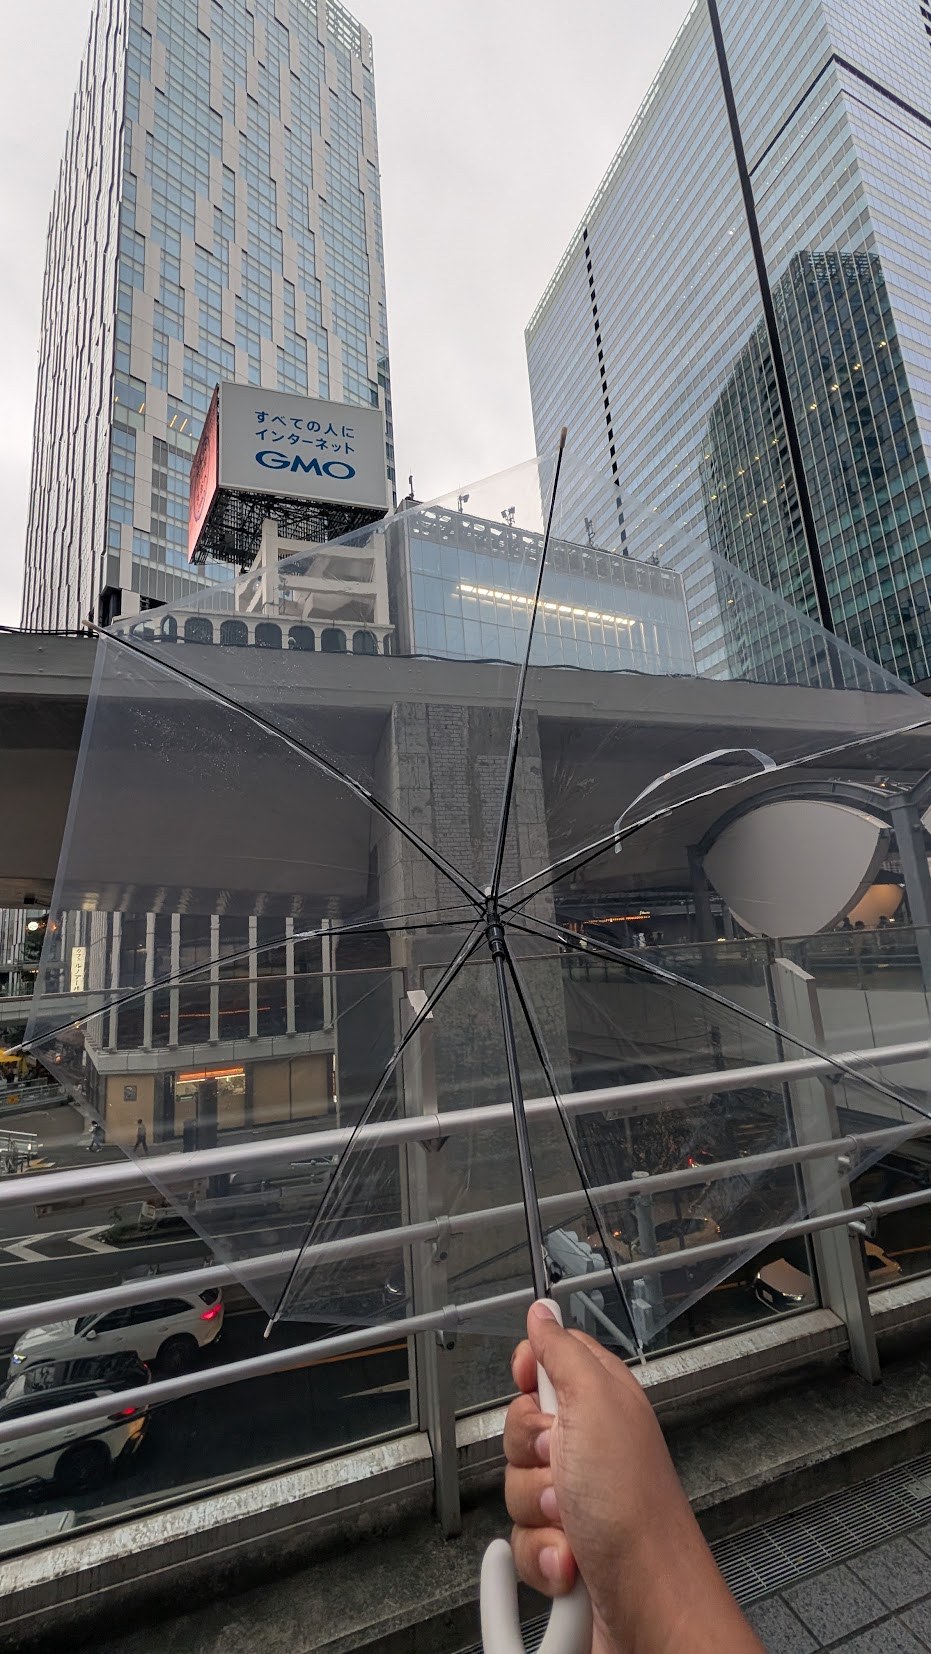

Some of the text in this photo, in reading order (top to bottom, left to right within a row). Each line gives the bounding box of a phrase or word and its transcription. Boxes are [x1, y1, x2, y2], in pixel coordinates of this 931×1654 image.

[255, 411, 355, 438] すべての人に
[255, 429, 355, 454] インターネット
[255, 450, 356, 480] GMO
